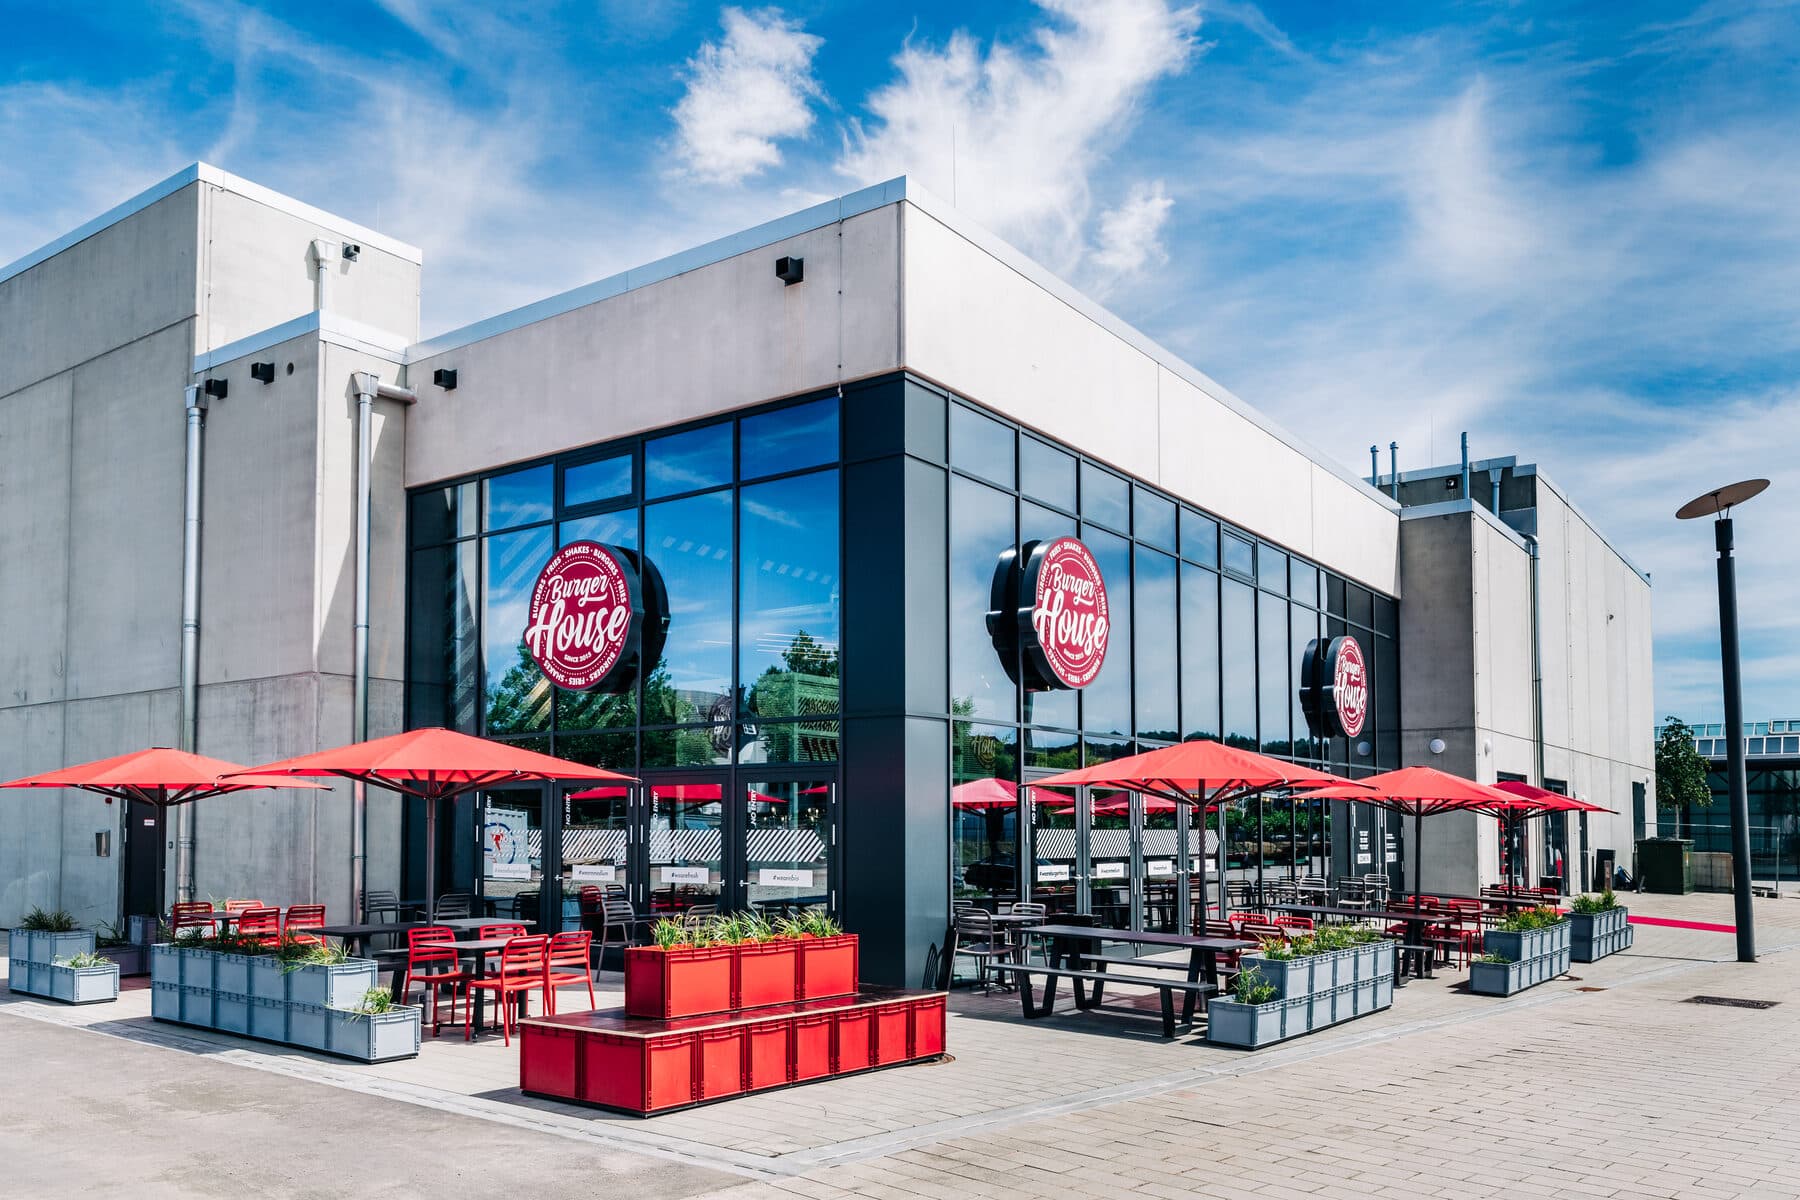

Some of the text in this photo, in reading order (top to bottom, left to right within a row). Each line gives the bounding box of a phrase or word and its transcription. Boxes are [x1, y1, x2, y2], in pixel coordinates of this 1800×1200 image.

[1064, 541, 1082, 555] SHAKES
[532, 545, 627, 619] BURGERS FRIES SHAKES BURGERS FRIES
[547, 574, 609, 607] Burger
[1051, 562, 1095, 607] Burger
[525, 600, 631, 661] House
[1034, 588, 1109, 656] House
[543, 652, 616, 686] BURGERS FRIES SHAKES
[564, 653, 579, 663] SINCE
[1340, 654, 1361, 682] Burger
[1333, 672, 1367, 715] House
